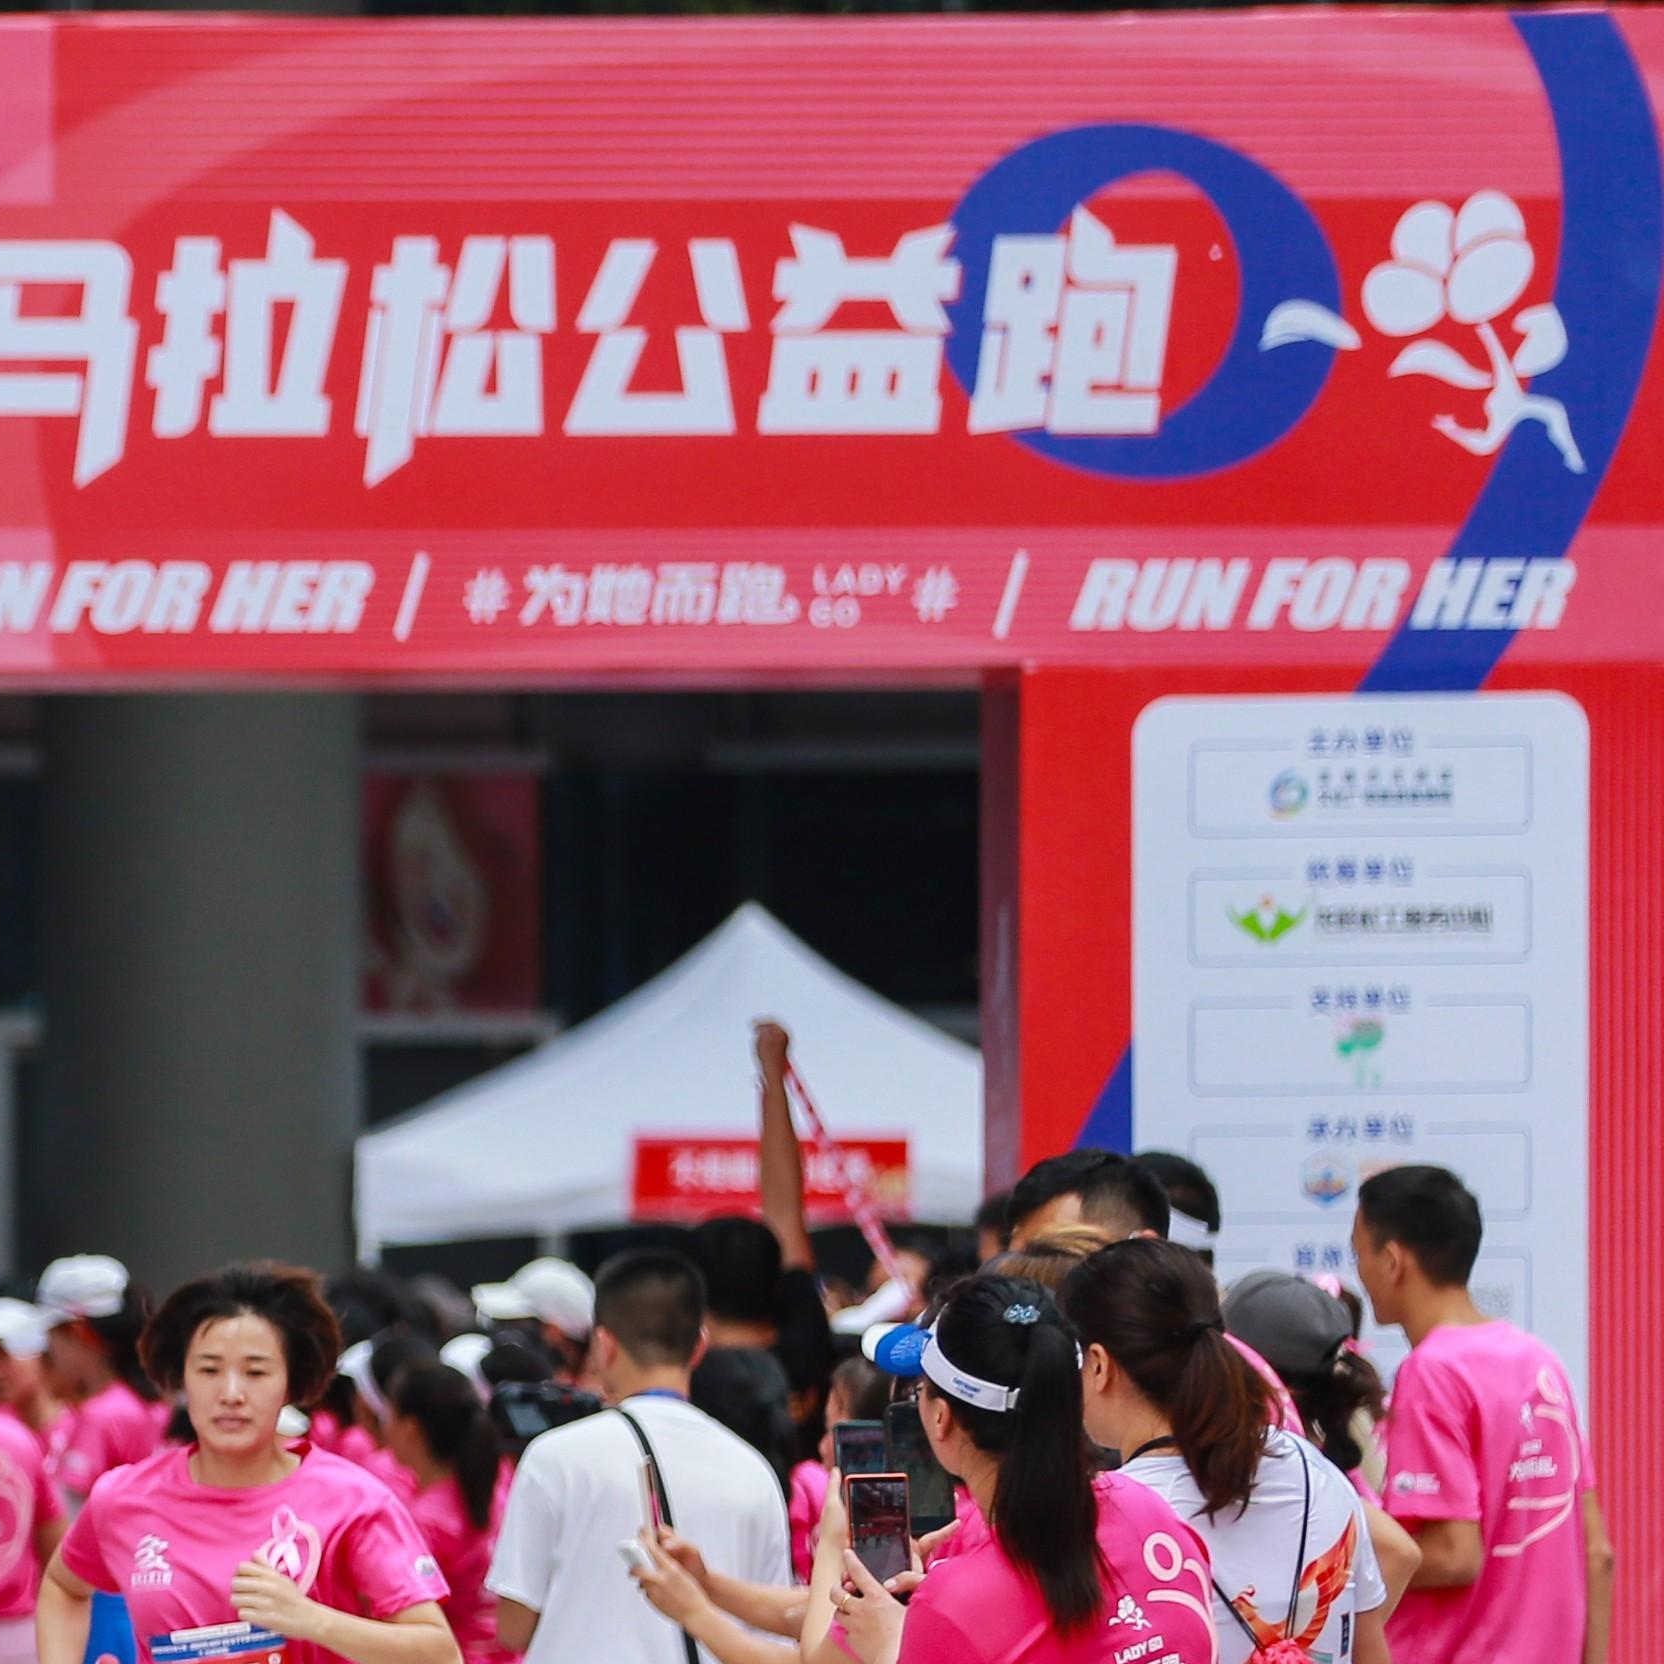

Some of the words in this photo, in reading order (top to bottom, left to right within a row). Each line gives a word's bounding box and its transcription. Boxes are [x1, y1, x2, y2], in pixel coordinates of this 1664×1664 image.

[48, 560, 213, 634] FOR
[209, 560, 376, 634] HER
[1069, 557, 1251, 631] RUN
[1247, 557, 1410, 632] FOR
[1408, 557, 1578, 631] HER
[1114, 1640, 1148, 1664] LADY
